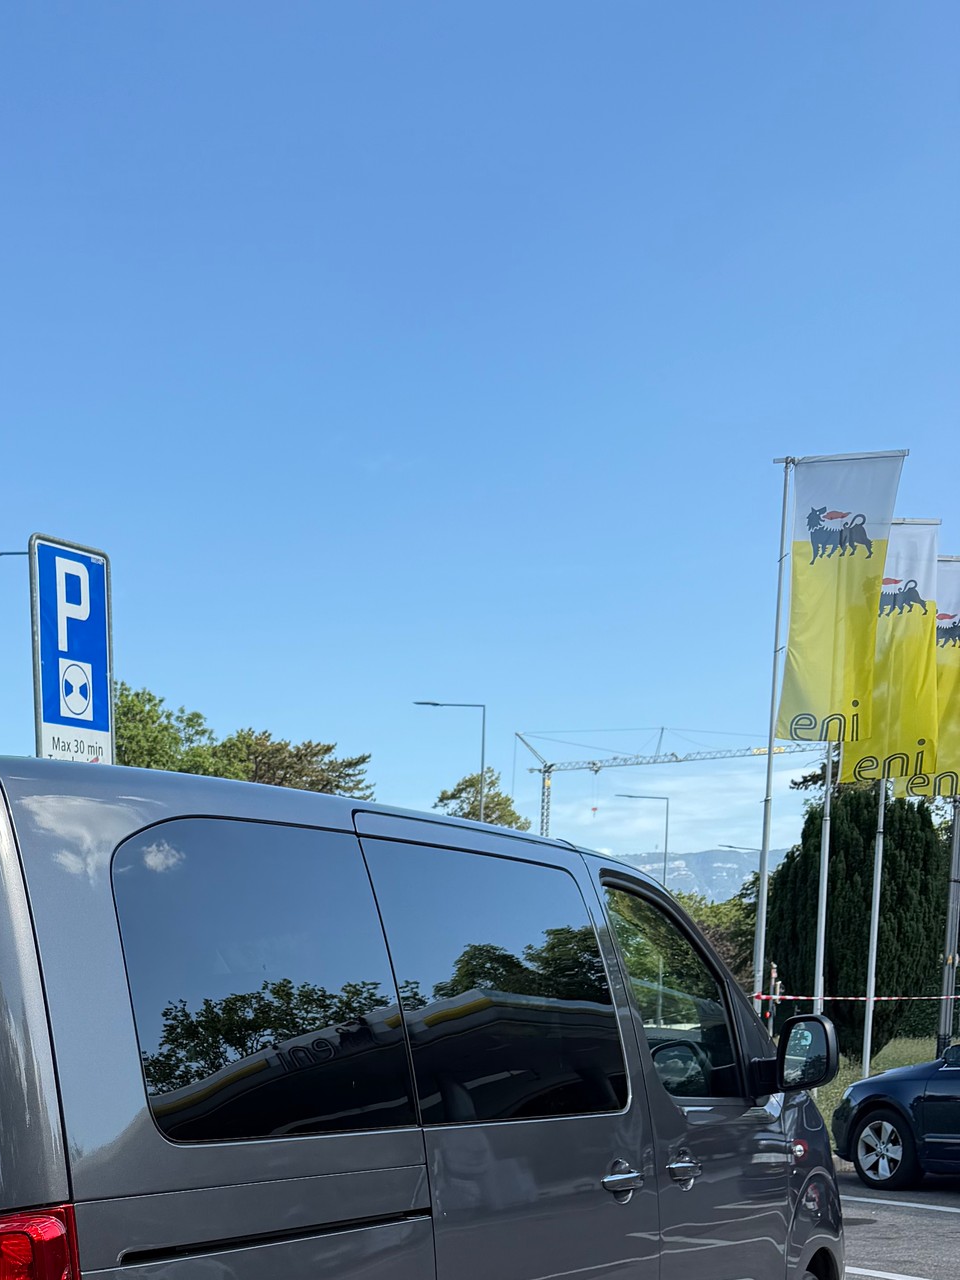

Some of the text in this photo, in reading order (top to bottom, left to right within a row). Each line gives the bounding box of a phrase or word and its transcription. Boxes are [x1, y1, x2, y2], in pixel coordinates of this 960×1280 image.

[55, 556, 90, 652] P
[790, 700, 859, 741] eni
[52, 736, 103, 756] Max 30 min
[853, 738, 925, 782] eni
[906, 771, 960, 796] en
